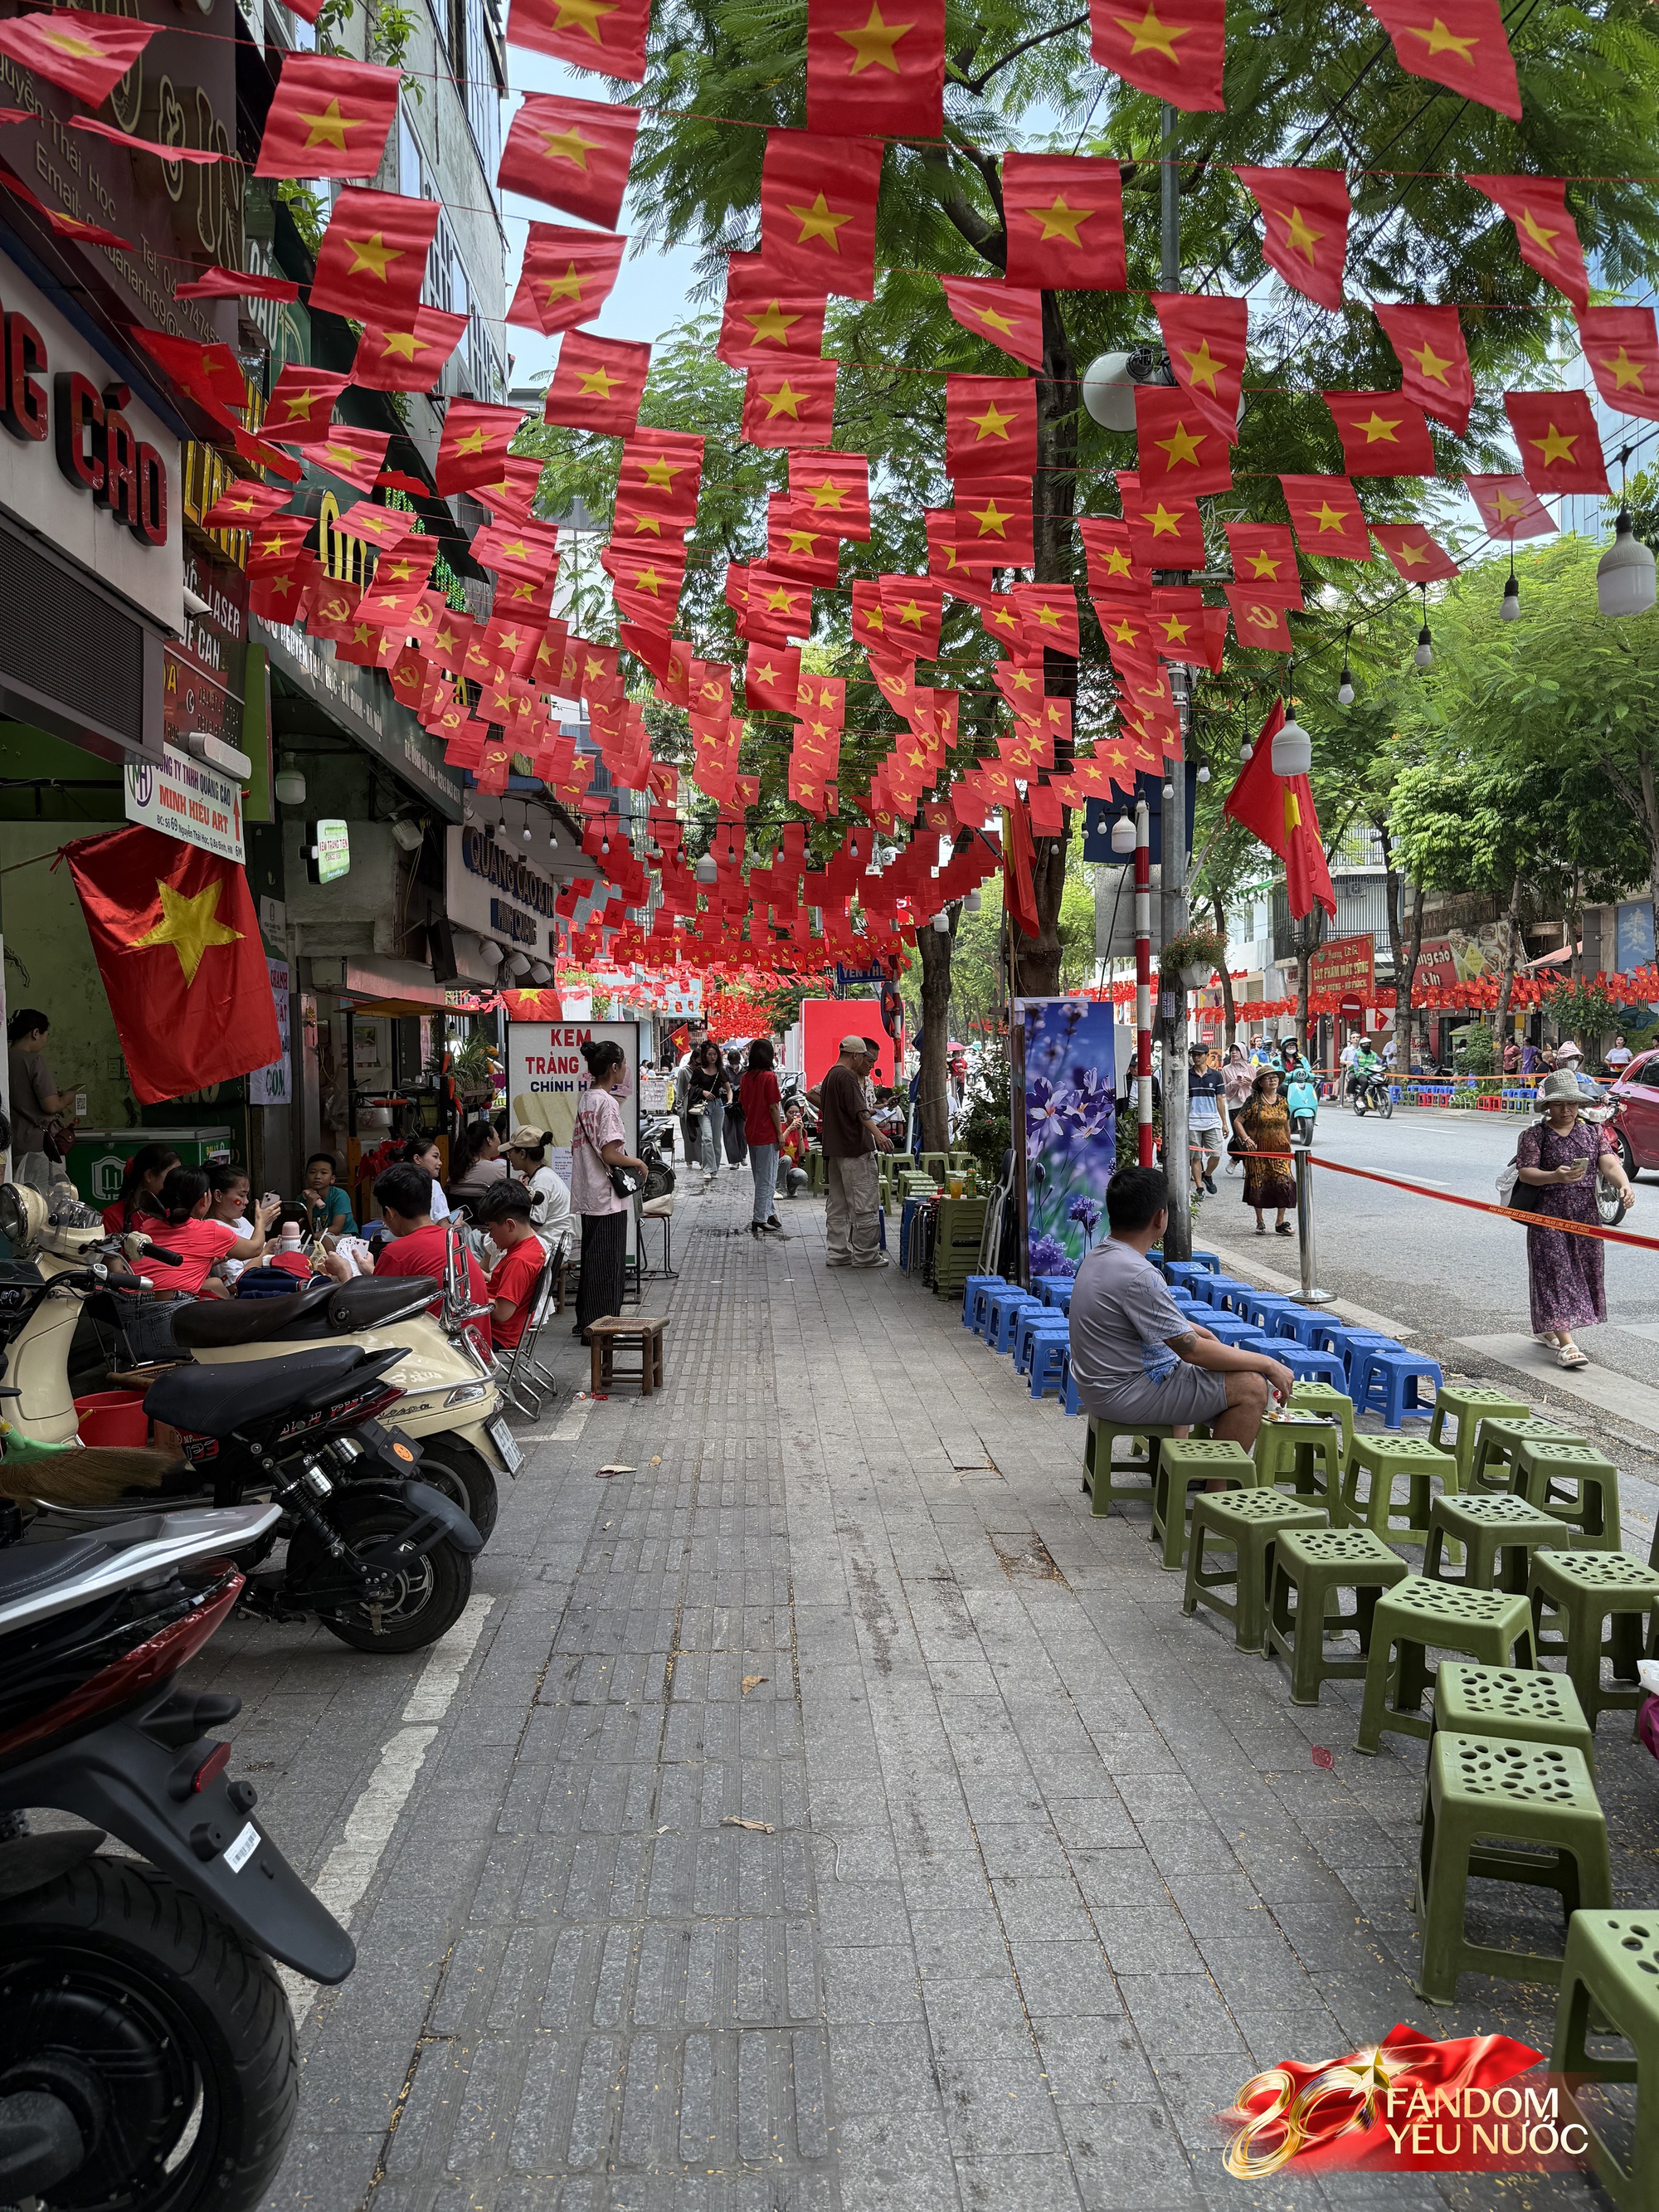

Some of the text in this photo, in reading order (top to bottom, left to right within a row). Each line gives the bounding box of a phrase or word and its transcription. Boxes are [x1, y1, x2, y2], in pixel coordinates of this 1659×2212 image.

[88, 163, 116, 222] Học
[55, 371, 168, 547] CÁO
[207, 583, 241, 639] LASER
[198, 626, 221, 671] CAN
[173, 758, 182, 782] TY
[182, 763, 199, 792] TNHH
[199, 771, 219, 801] QUẢNG
[220, 782, 231, 807] CÁO
[158, 784, 229, 835] MINH HIẾU ART
[170, 816, 178, 831] 69
[178, 825, 193, 838] Nguyễn
[192, 830, 202, 841] Thái
[270, 968, 288, 990] CHANH
[1422, 972, 1441, 987] & In
[551, 1029, 592, 1047] KEM
[531, 1076, 574, 1093] CHÍNH
